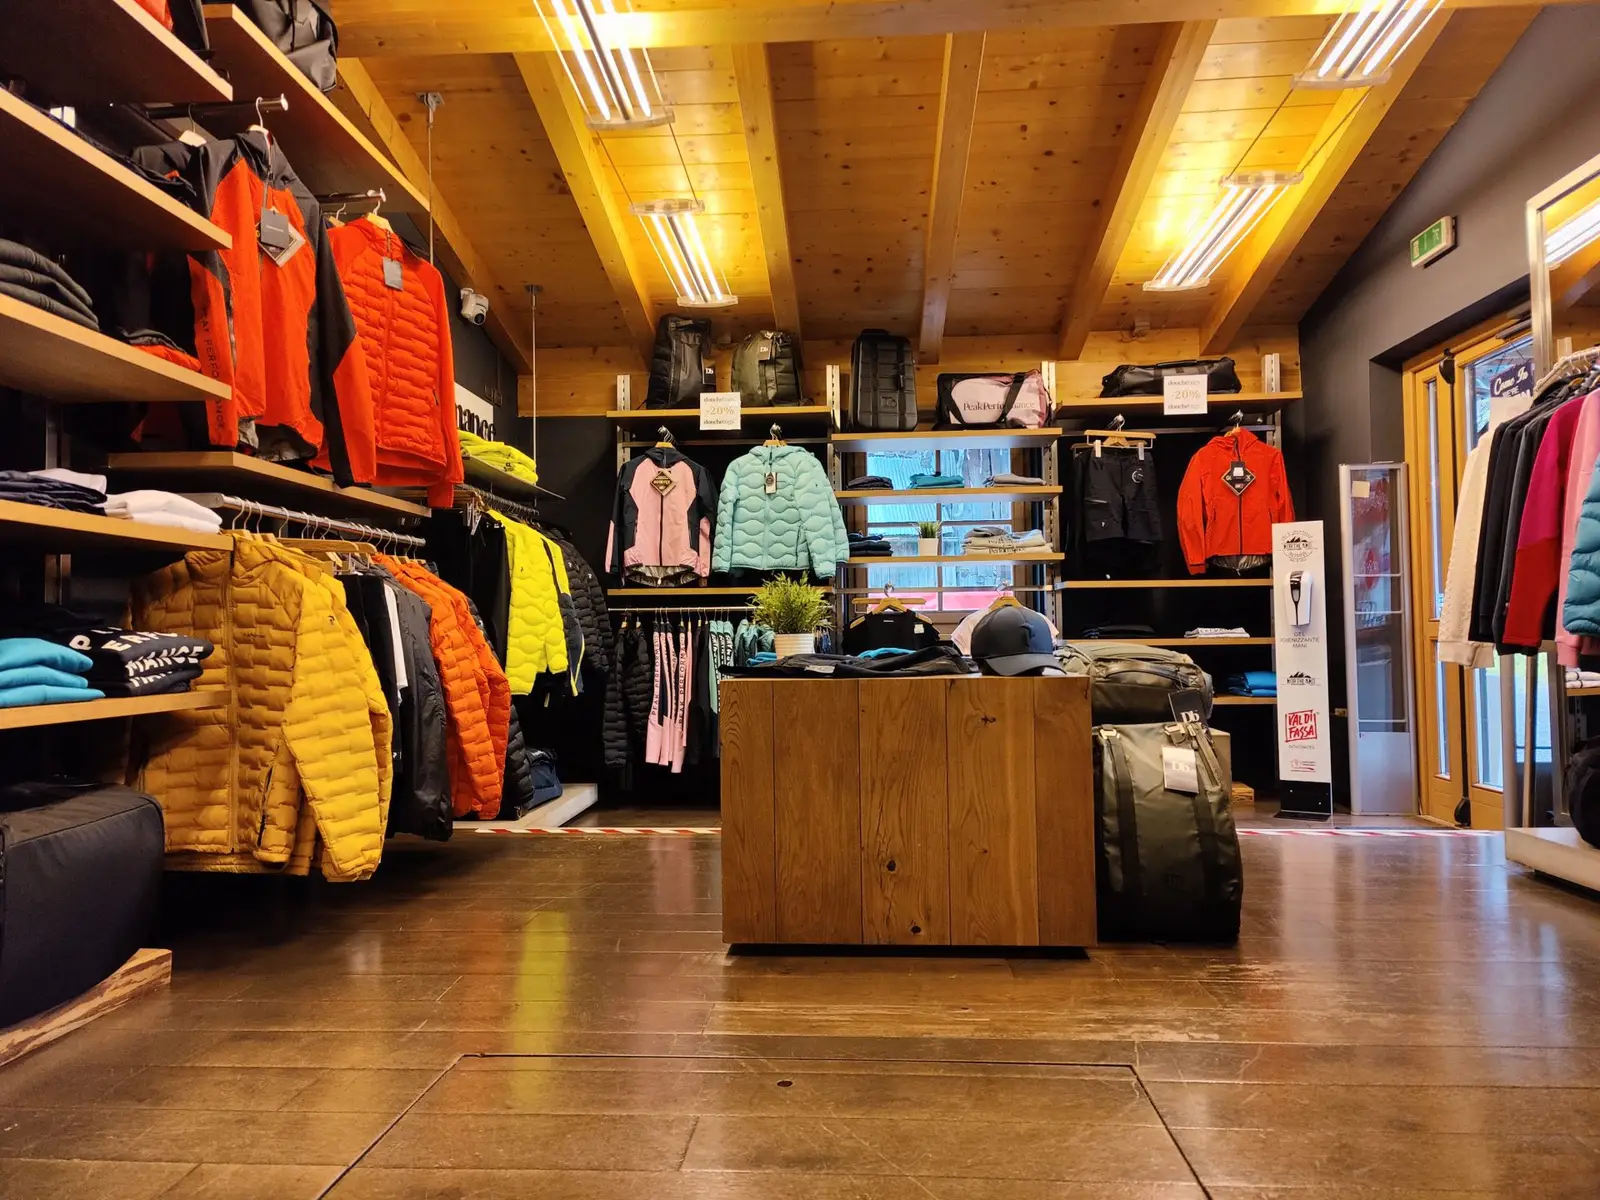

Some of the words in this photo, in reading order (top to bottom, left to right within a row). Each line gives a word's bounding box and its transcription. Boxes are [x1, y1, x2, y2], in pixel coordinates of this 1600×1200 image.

[706, 406, 735, 416] -20%
[1180, 709, 1200, 723] Db
[1288, 714, 1302, 726] VAL
[1288, 725, 1314, 739] FASSA
